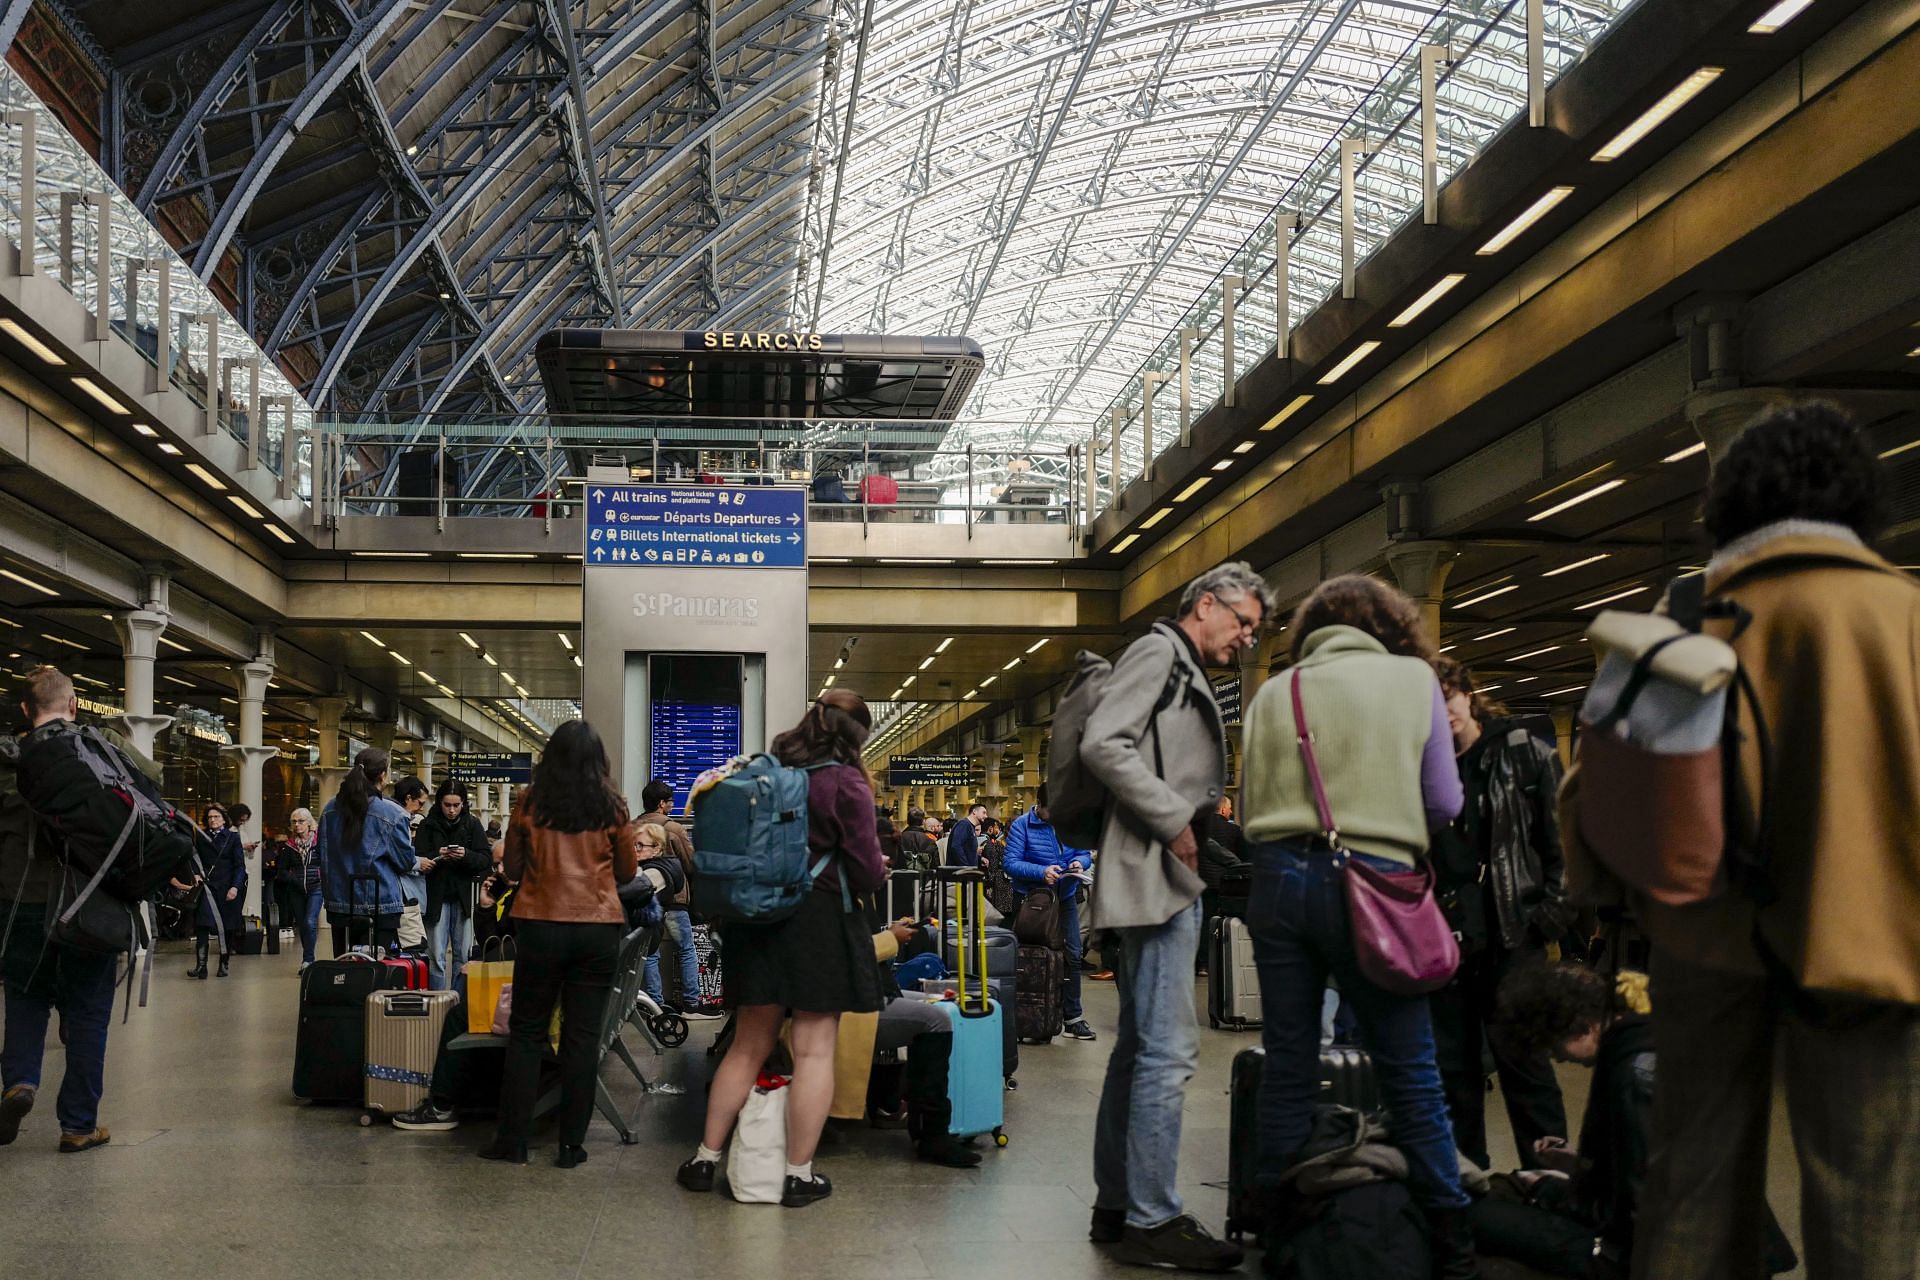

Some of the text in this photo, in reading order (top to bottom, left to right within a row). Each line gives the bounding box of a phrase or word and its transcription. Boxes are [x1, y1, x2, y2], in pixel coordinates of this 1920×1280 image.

[704, 332, 822, 349] SEARCYS
[612, 491, 667, 503] All trains
[664, 511, 711, 525] Départs
[714, 512, 781, 526] Departures
[620, 530, 781, 544] Billets International tickets
[77, 697, 93, 711] PAIN
